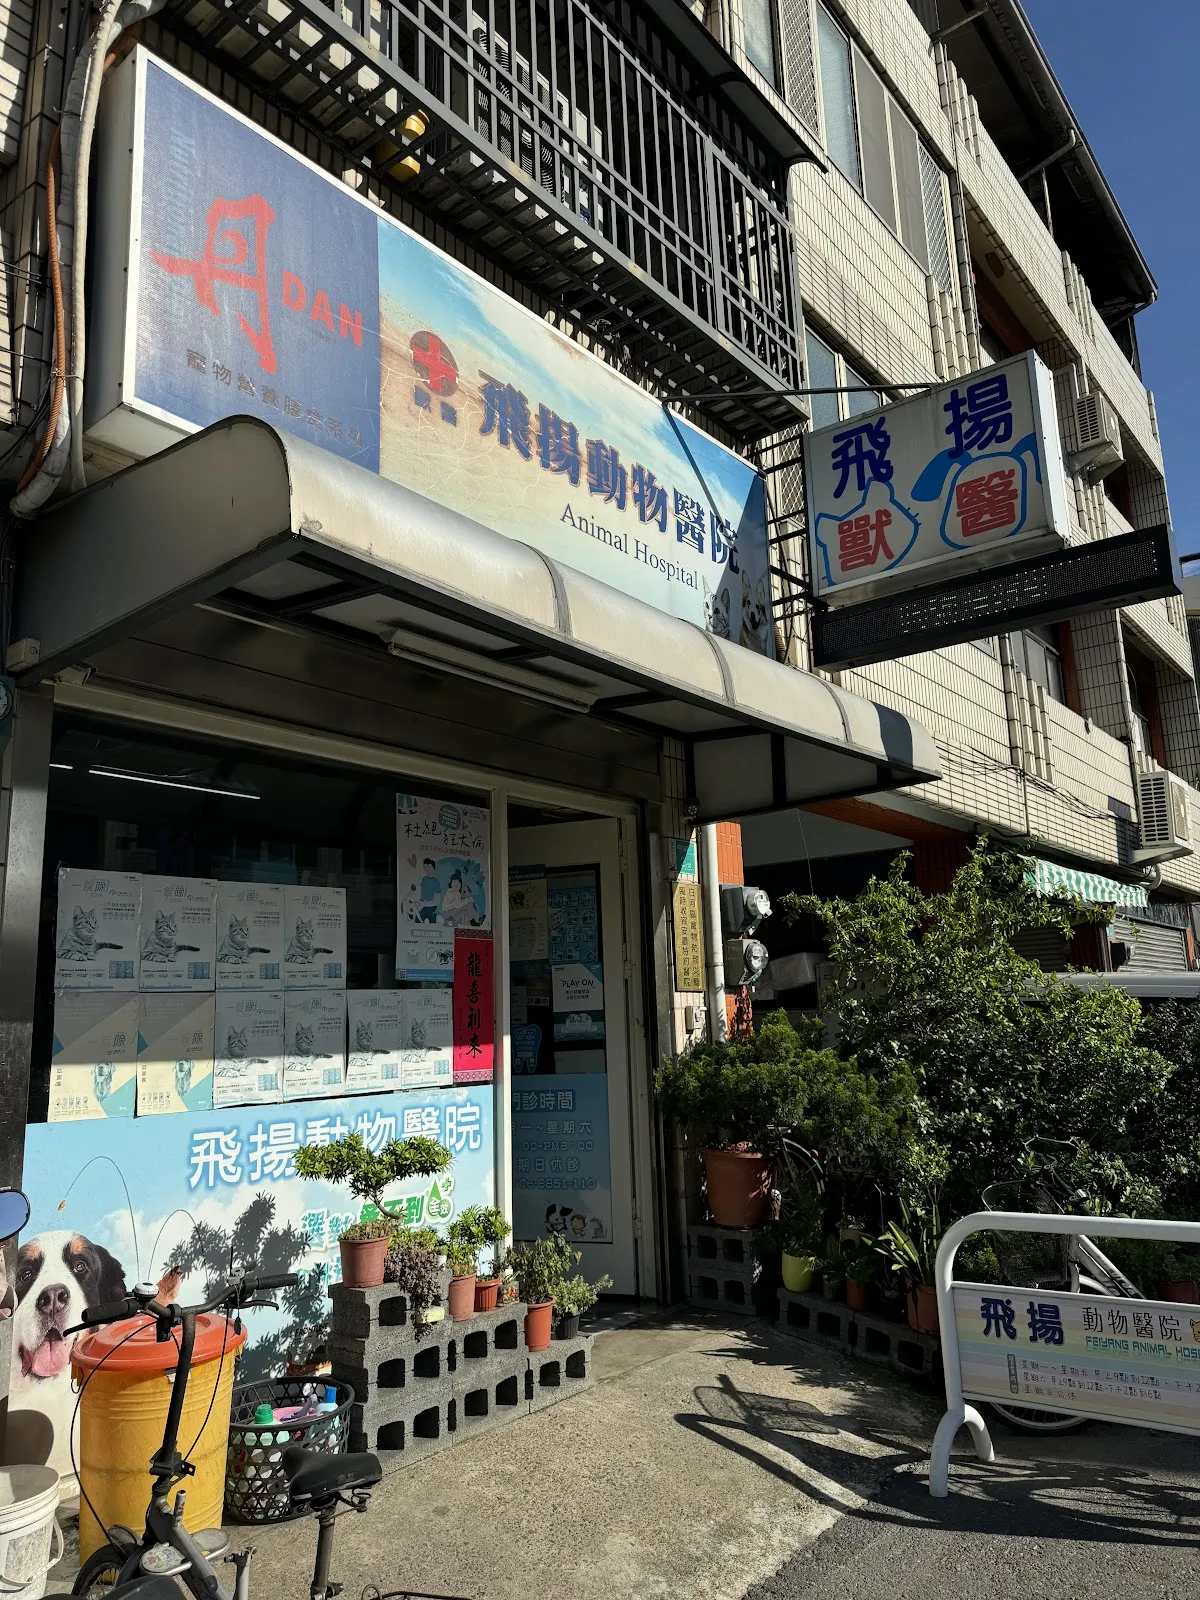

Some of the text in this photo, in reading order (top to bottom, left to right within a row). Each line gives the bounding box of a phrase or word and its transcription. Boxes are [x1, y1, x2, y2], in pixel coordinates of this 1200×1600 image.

[150, 194, 277, 374] 丹
[282, 270, 363, 347] DAN
[186, 348, 364, 448] 寵物營養膳食系列
[832, 373, 1013, 498] 飛揚
[478, 370, 740, 574] 飛揚動物醫院
[560, 502, 699, 591] Animal Hospital
[838, 469, 1018, 572] 獸醫
[562, 978, 594, 988] PLAY ON
[980, 1297, 1182, 1346] 飛揚 動物醫院
[1085, 1335, 1129, 1351] FEIYANG
[1132, 1340, 1172, 1356] ANIMAL
